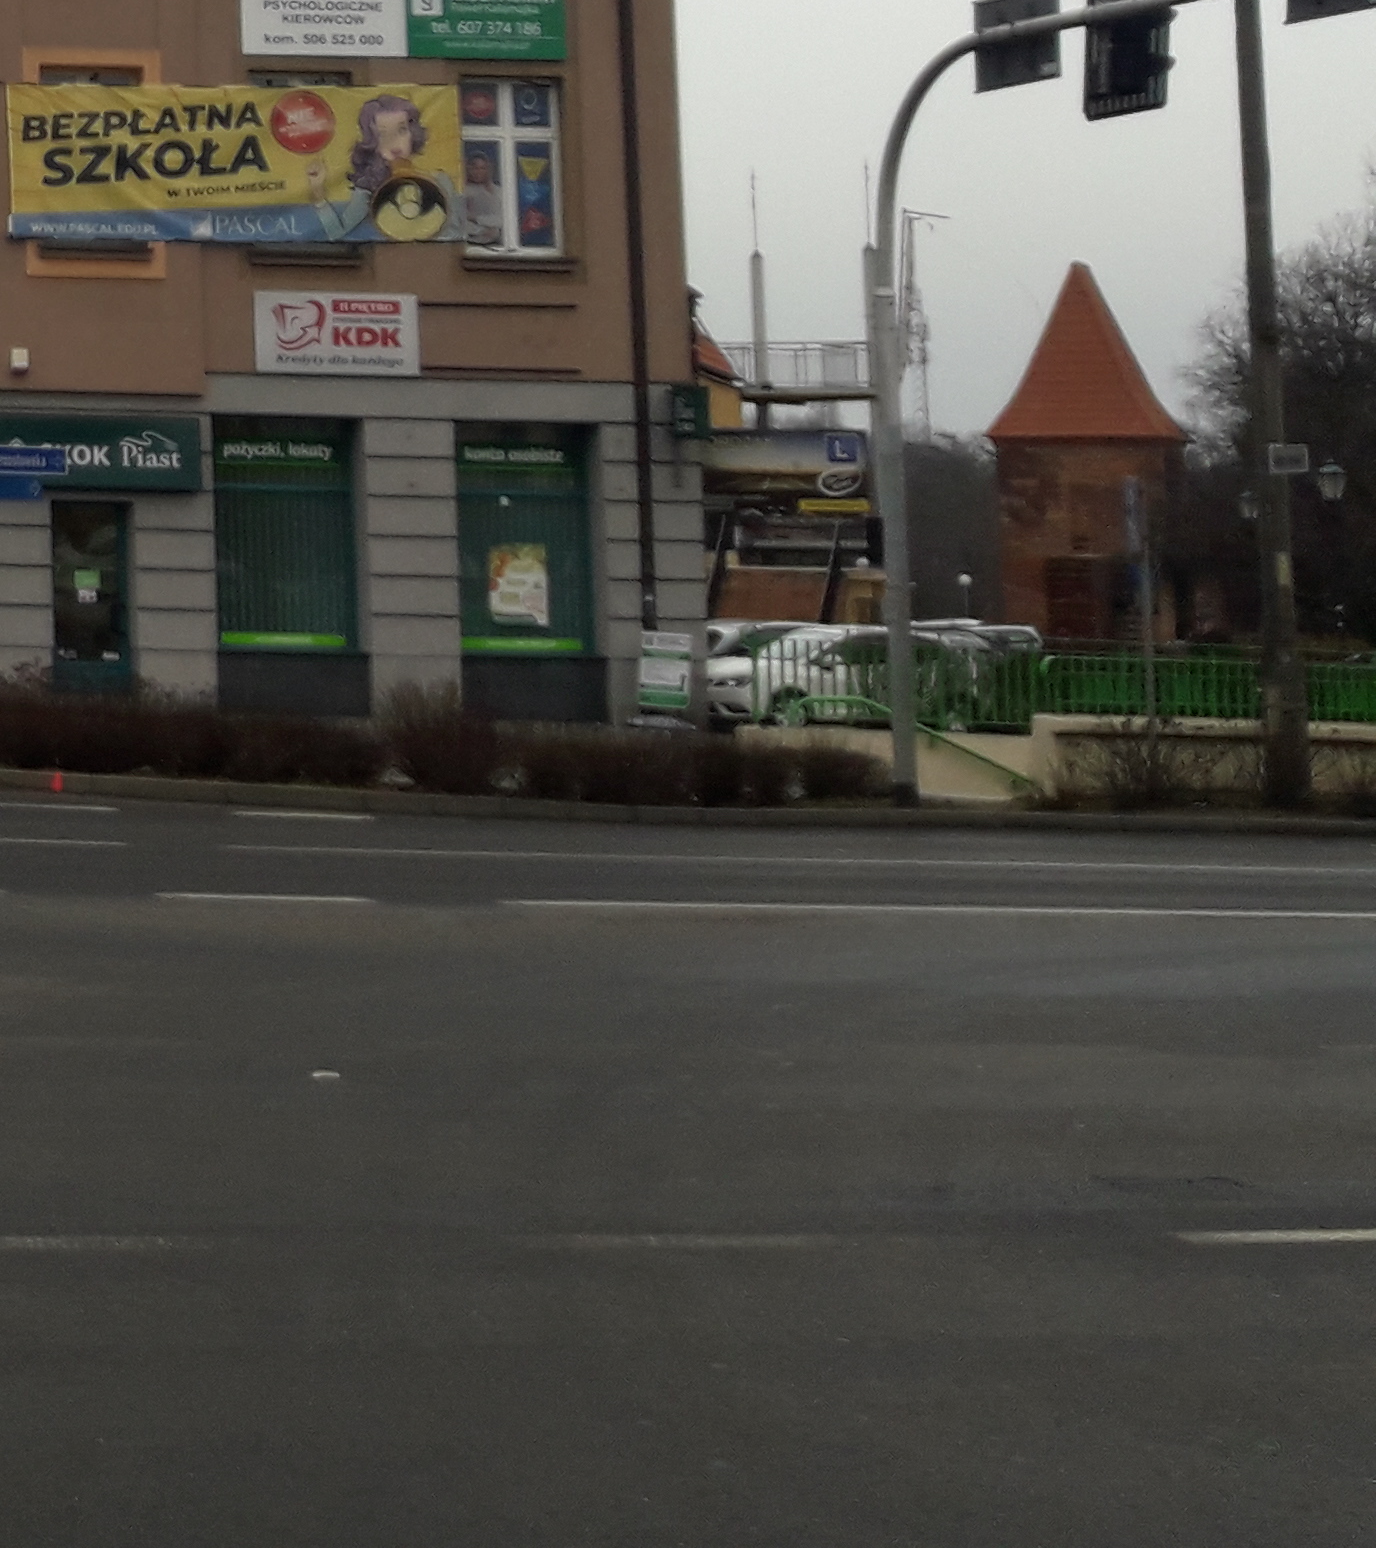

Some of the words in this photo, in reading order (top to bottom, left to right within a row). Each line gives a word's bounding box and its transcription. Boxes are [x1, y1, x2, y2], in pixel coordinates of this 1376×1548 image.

[263, 0, 383, 12] PSYCHOLOGICZNE
[21, 101, 264, 143] BEZPŁATNA
[41, 134, 270, 187] SZKOŁA
[214, 214, 304, 236] PASCAL
[331, 325, 403, 348] KDK
[121, 441, 182, 468] Piast
